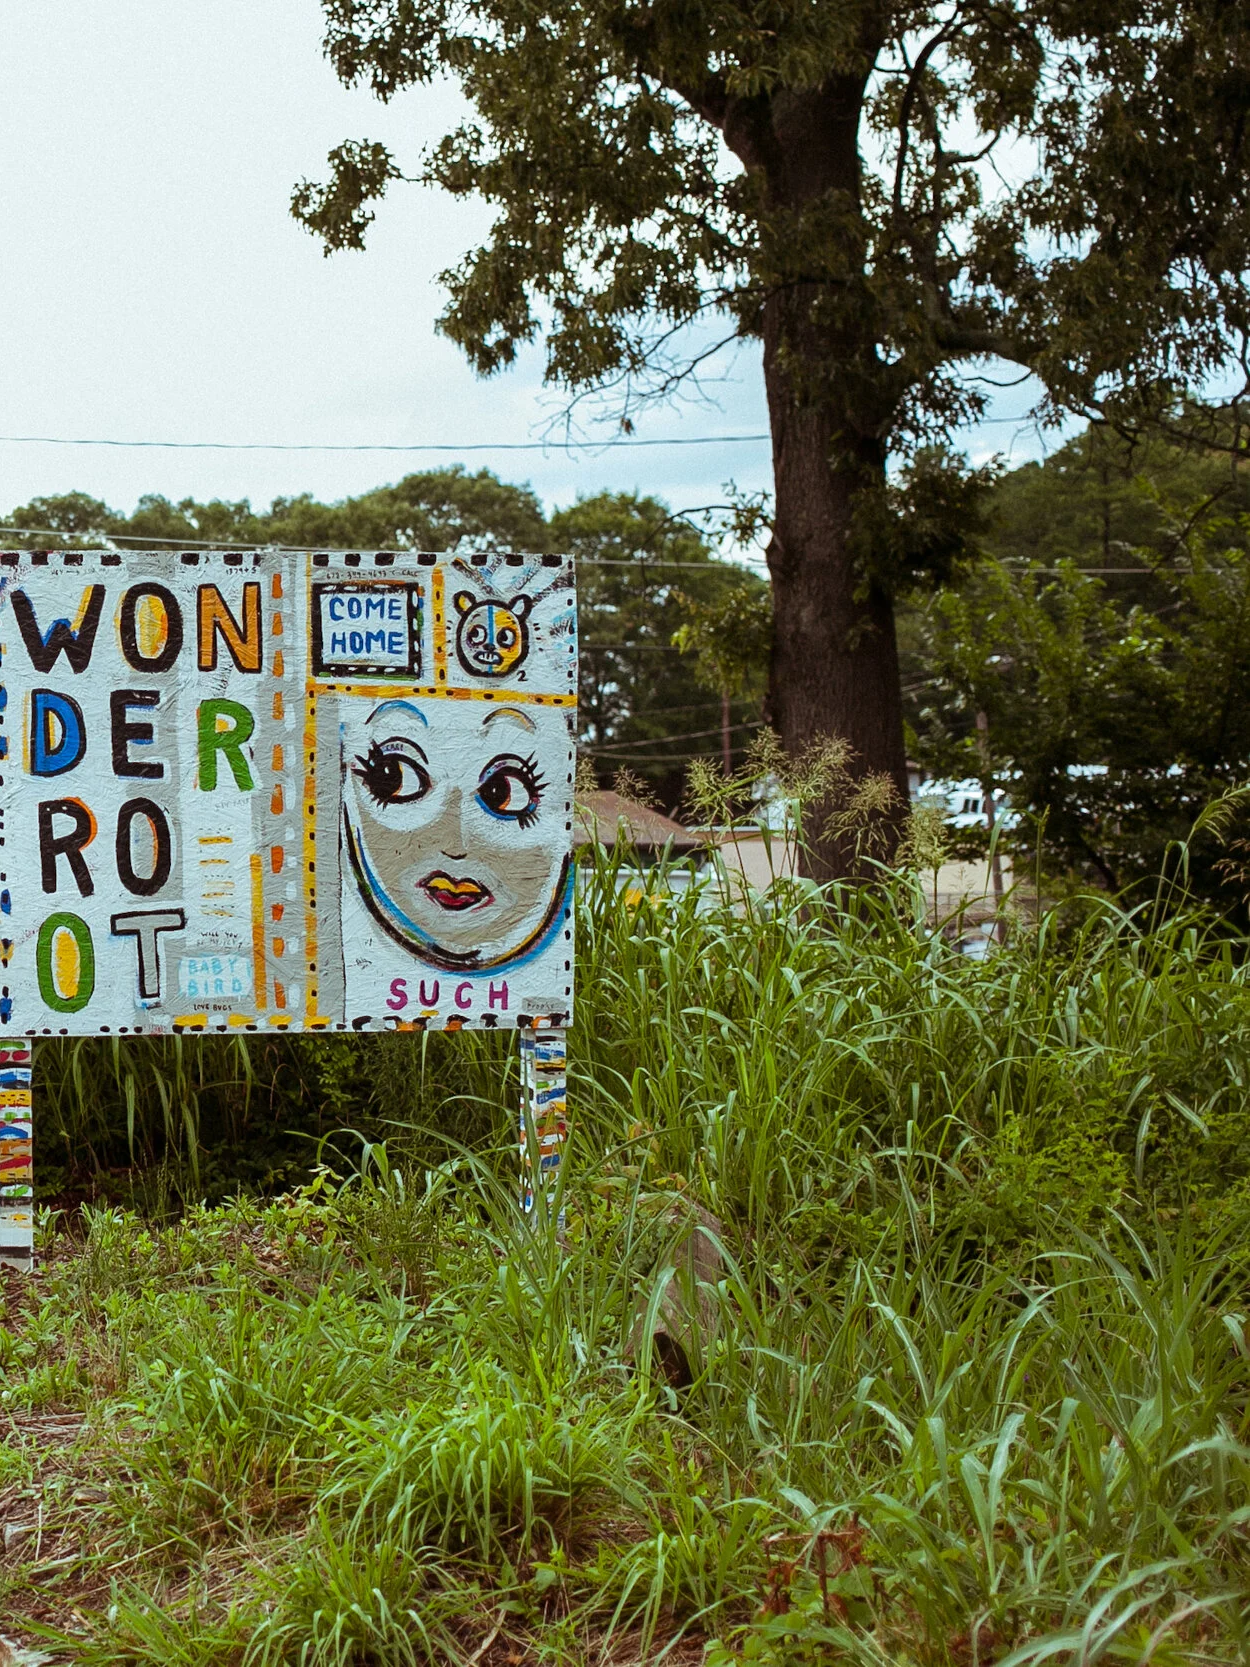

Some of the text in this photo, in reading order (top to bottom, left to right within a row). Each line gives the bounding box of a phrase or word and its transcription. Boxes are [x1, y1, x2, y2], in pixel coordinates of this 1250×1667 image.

[329, 597, 403, 621] COME
[10, 581, 263, 675] WON
[330, 630, 403, 655] HOME
[516, 670, 529, 682] 2
[29, 688, 256, 792] DER
[38, 796, 171, 898] RO
[36, 907, 188, 1013] OT
[188, 956, 238, 976] BABY
[188, 977, 243, 997] BIRD
[386, 978, 508, 1011] SUCH
